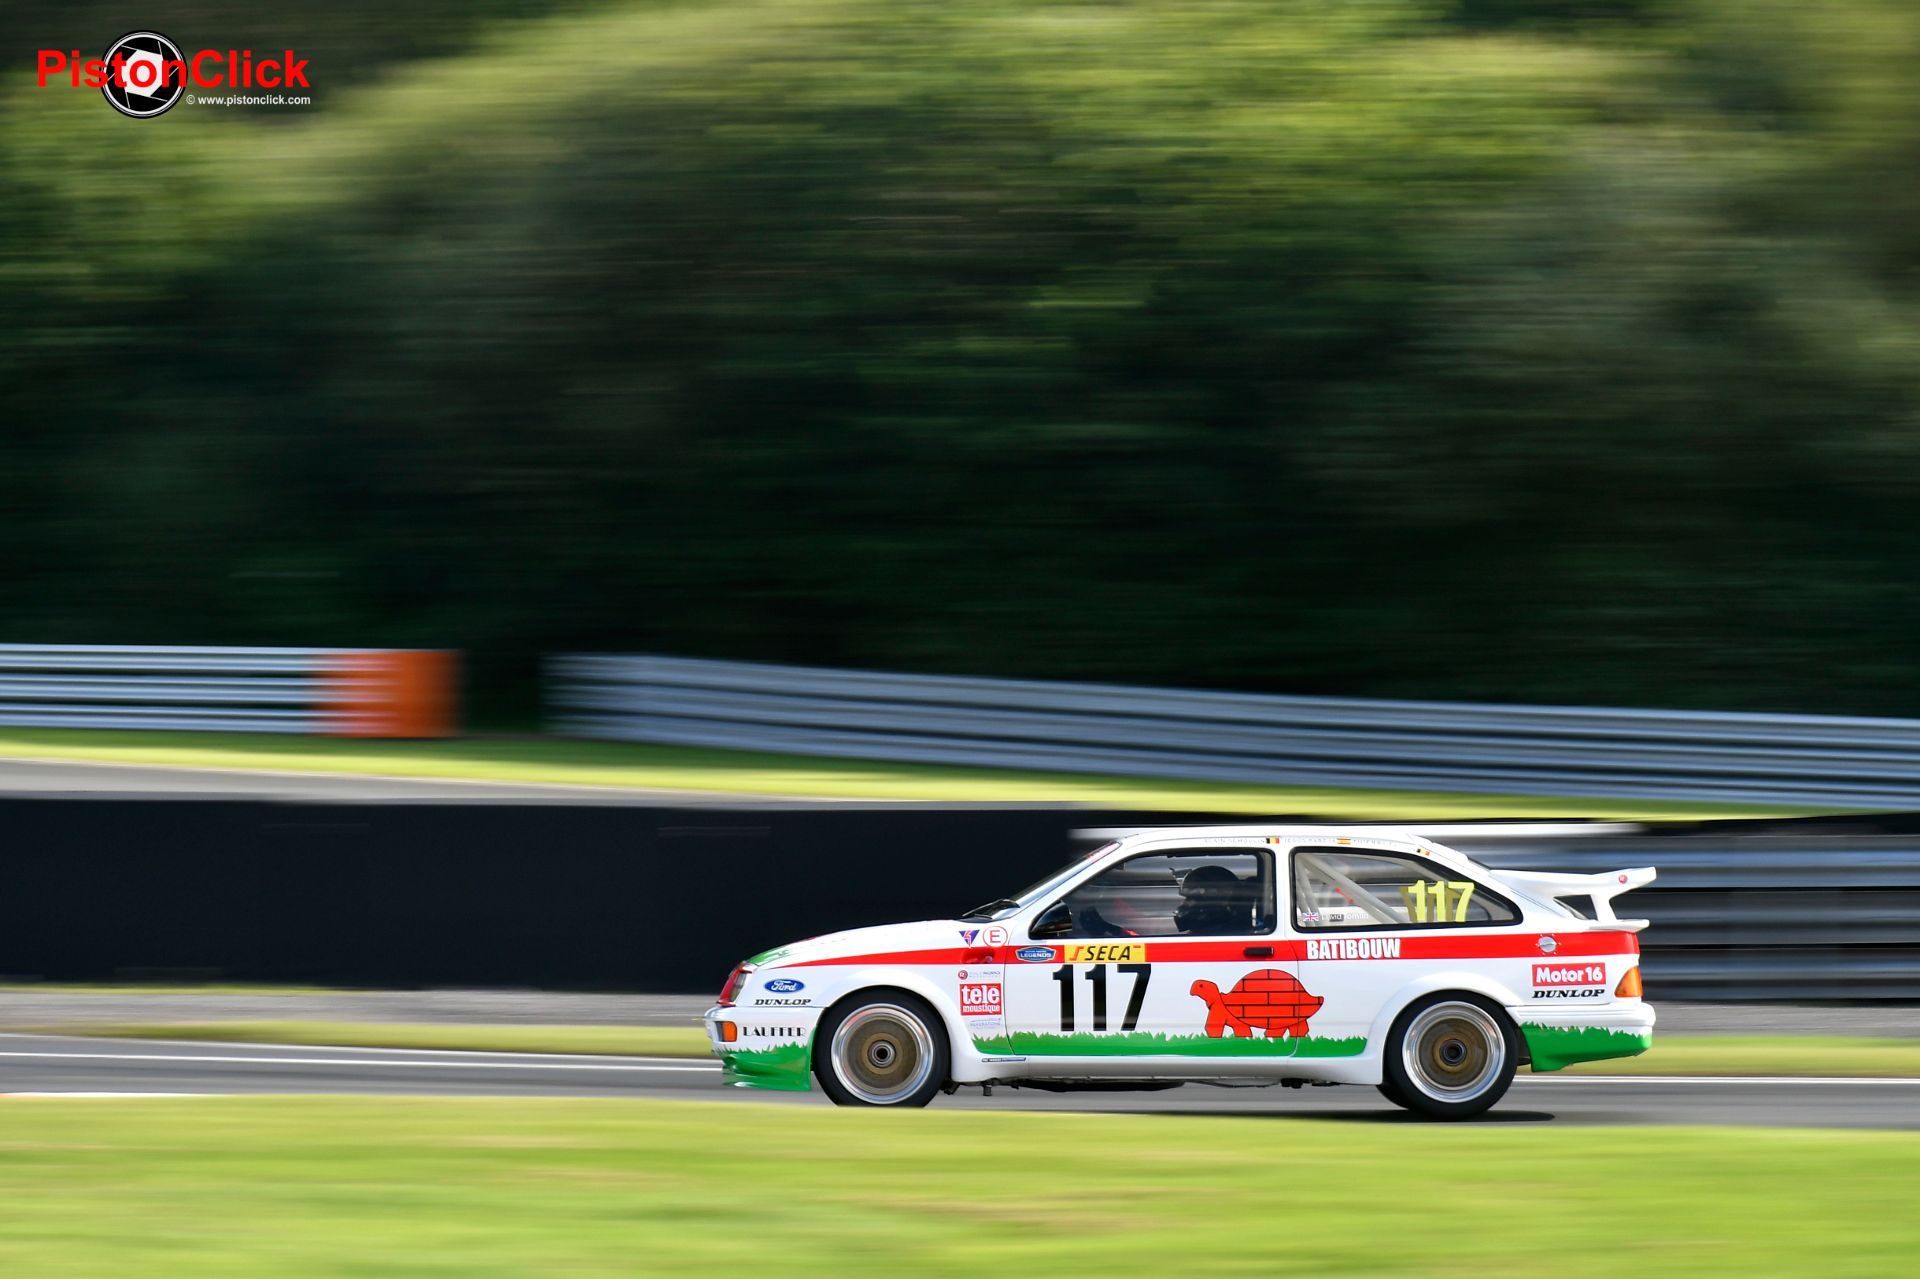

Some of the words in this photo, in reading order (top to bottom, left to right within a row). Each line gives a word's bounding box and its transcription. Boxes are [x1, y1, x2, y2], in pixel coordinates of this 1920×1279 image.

[1408, 880, 1475, 922] 117
[1085, 946, 1131, 960] SECA
[1306, 938, 1400, 960] BATIBOUW
[1536, 967, 1585, 983] Motor
[1585, 966, 1603, 982] 16
[770, 980, 798, 991] Ford
[1052, 963, 1152, 1031] 117
[1532, 989, 1605, 998] DUNLOP
[962, 1004, 1001, 1013] moustique
